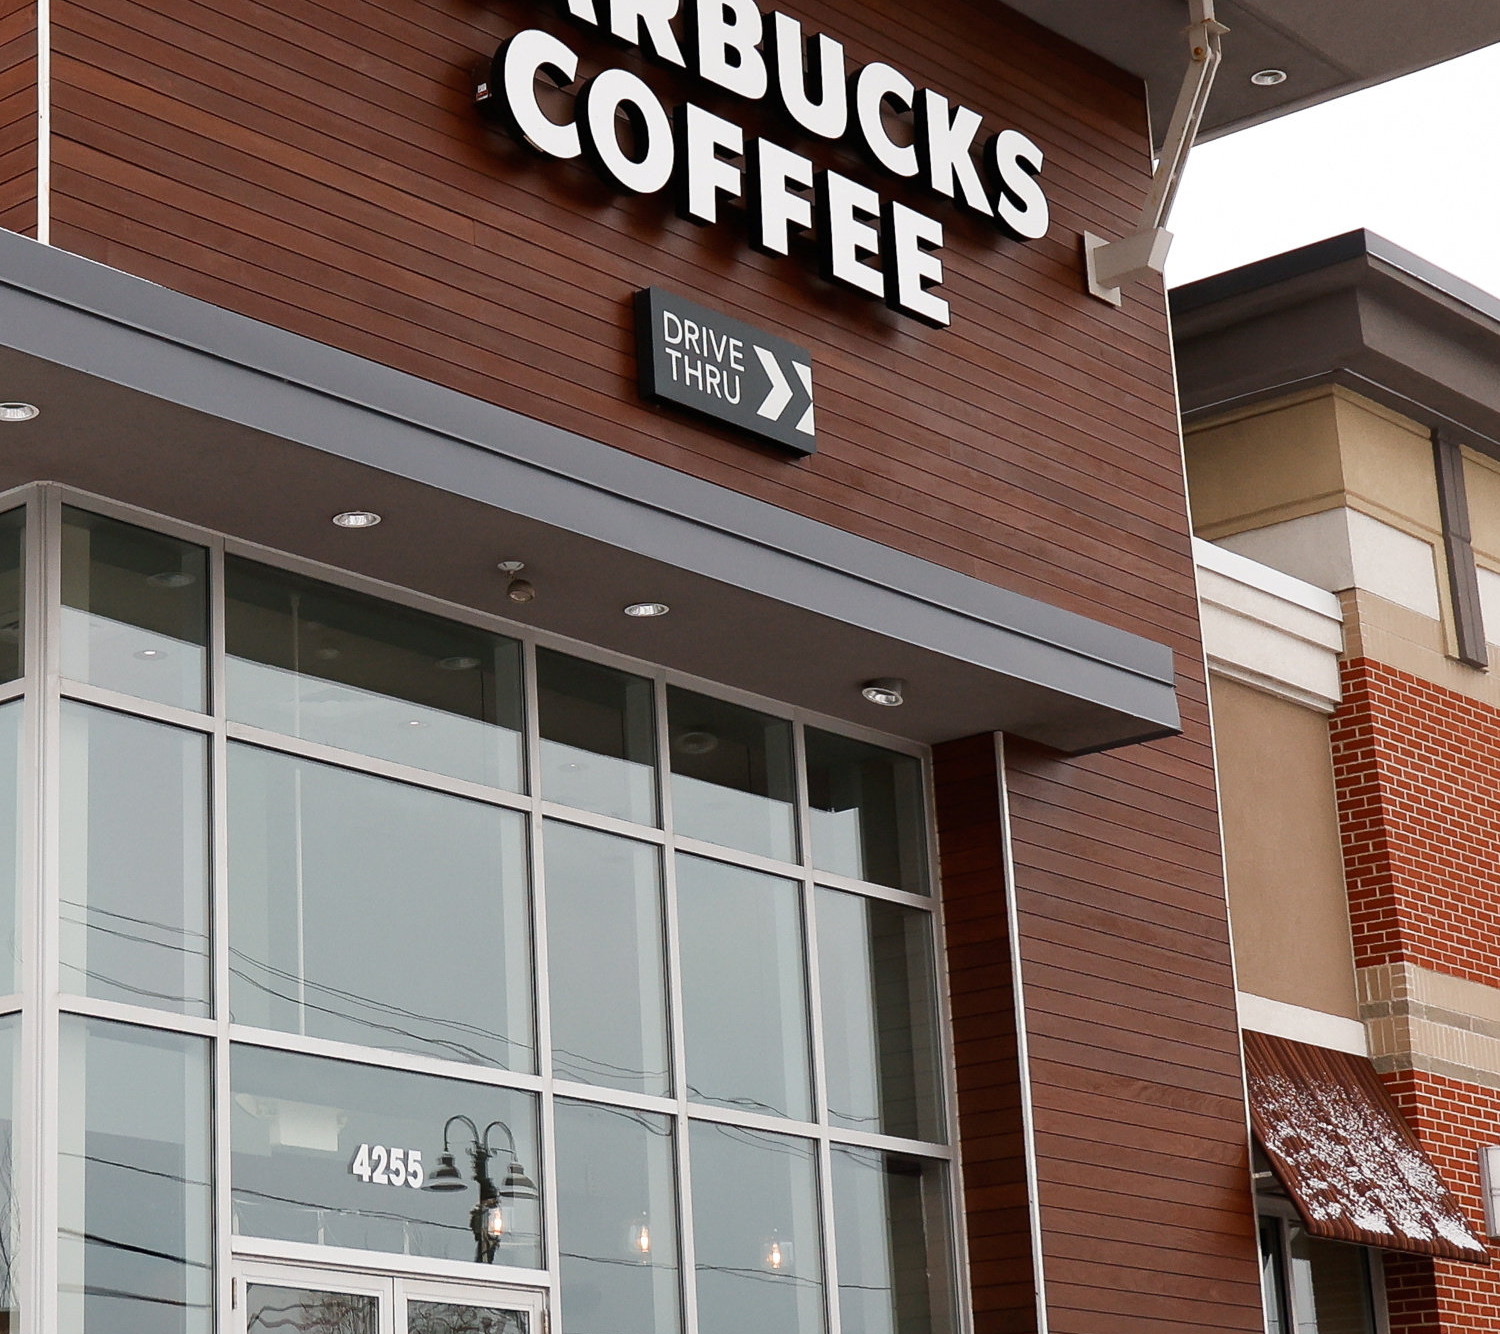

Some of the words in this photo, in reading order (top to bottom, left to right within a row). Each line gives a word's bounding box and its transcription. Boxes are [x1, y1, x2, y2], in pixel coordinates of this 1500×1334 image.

[501, 28, 951, 327] COFFEE
[663, 310, 745, 372] DRIVE
[665, 347, 741, 405] THRU
[352, 1143, 424, 1189] 4255
